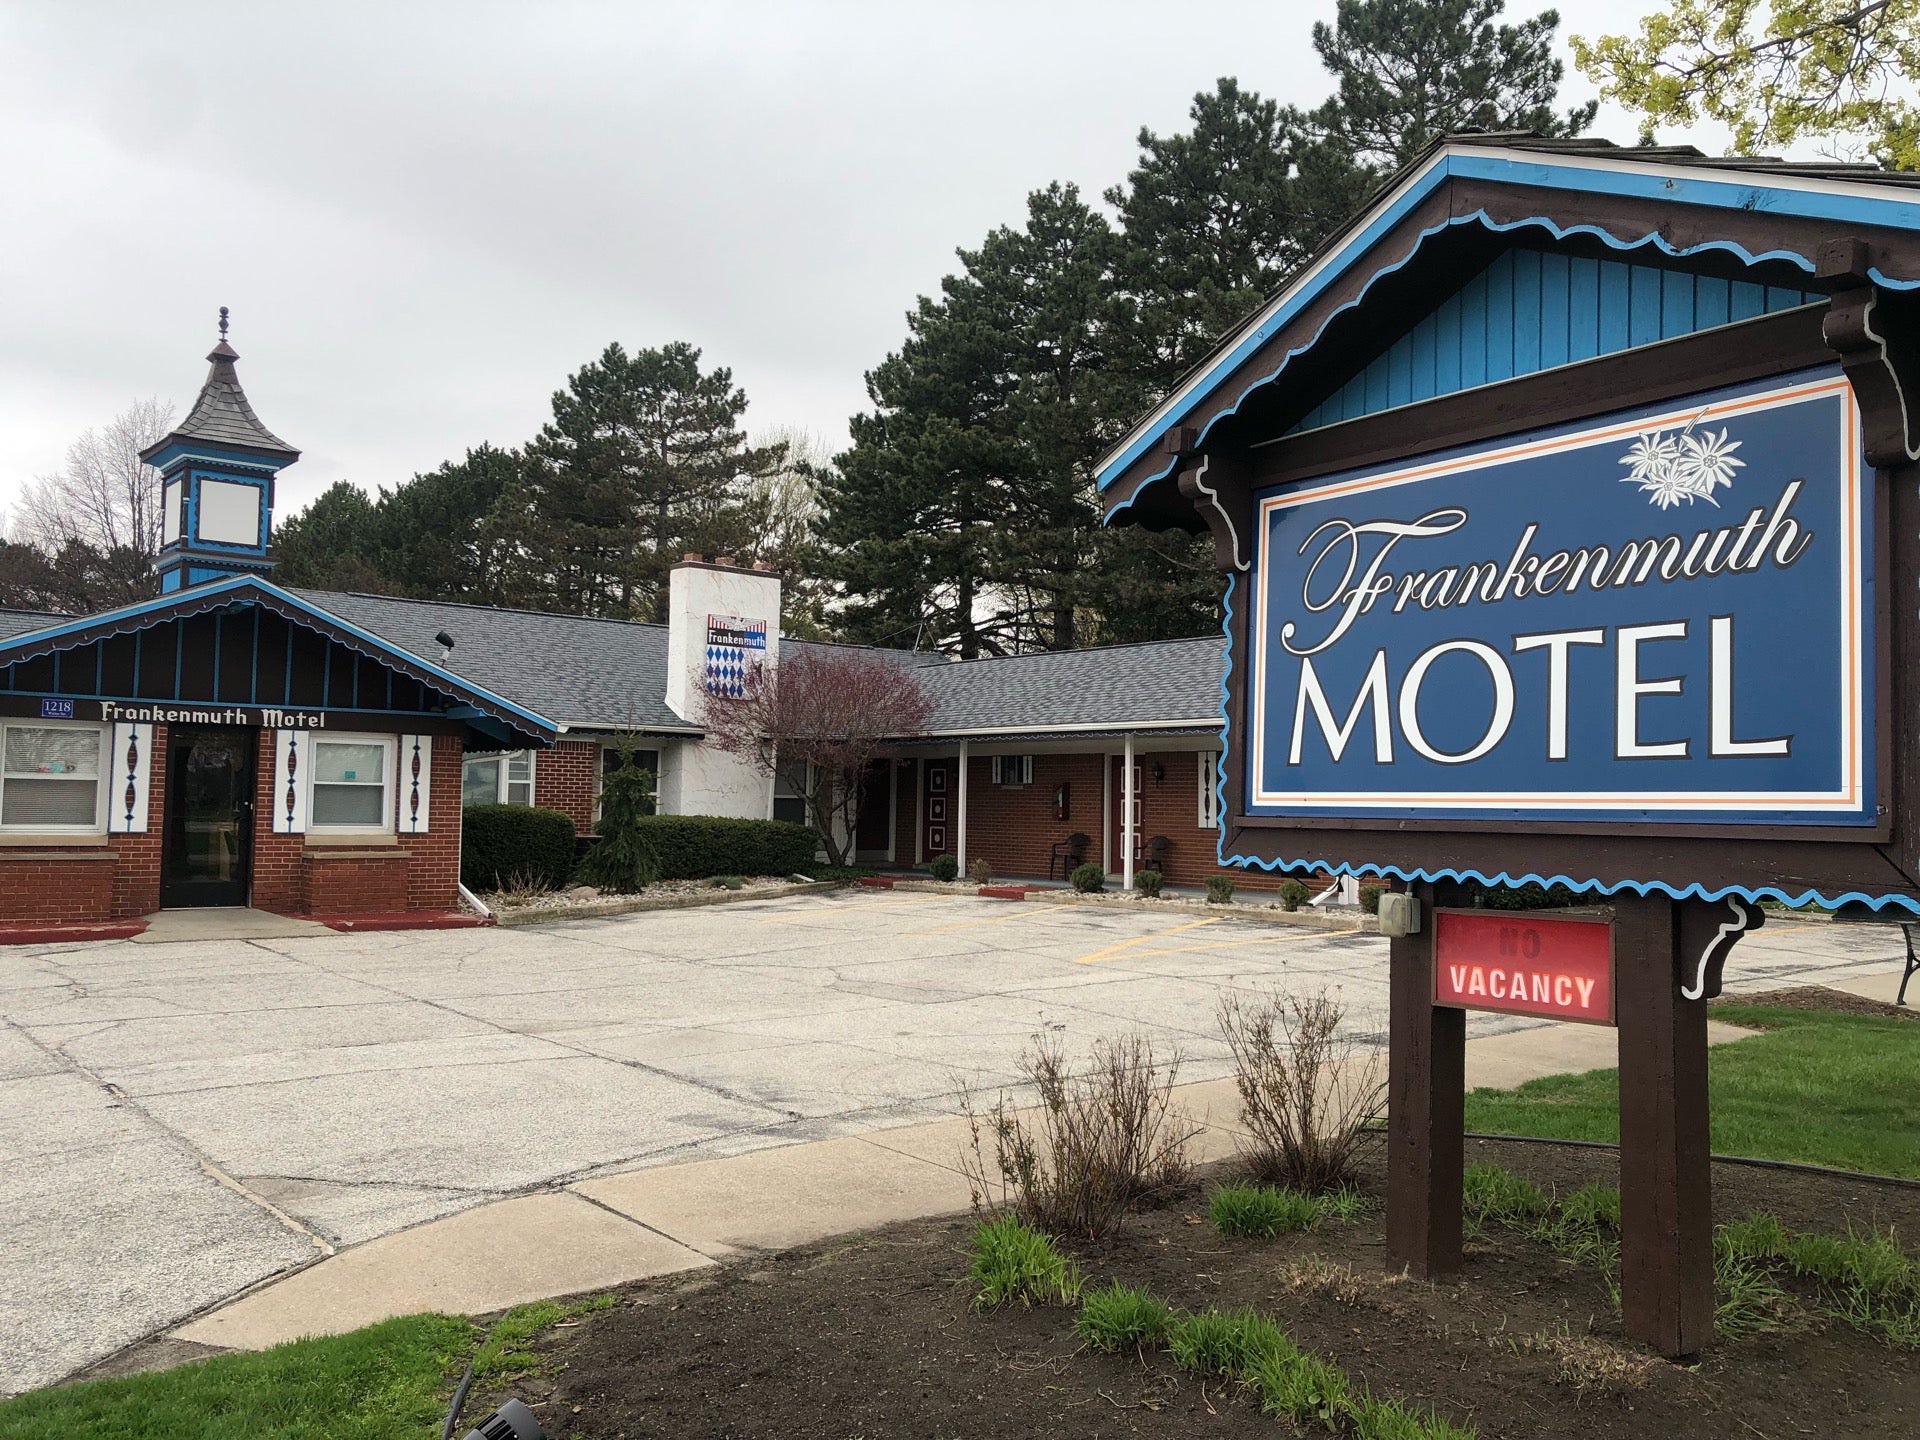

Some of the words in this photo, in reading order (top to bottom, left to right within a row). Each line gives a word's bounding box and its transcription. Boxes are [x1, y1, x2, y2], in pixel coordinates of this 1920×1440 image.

[1281, 478, 1813, 655] Frankenmuth
[708, 630, 765, 647] Frankenmuth
[1287, 613, 1795, 766] MOTEL
[44, 701, 71, 712] 1218
[99, 701, 248, 725] Frankenmuth
[261, 708, 325, 728] Motel
[1500, 926, 1541, 959] NO
[1449, 963, 1596, 1009] VACANCY
